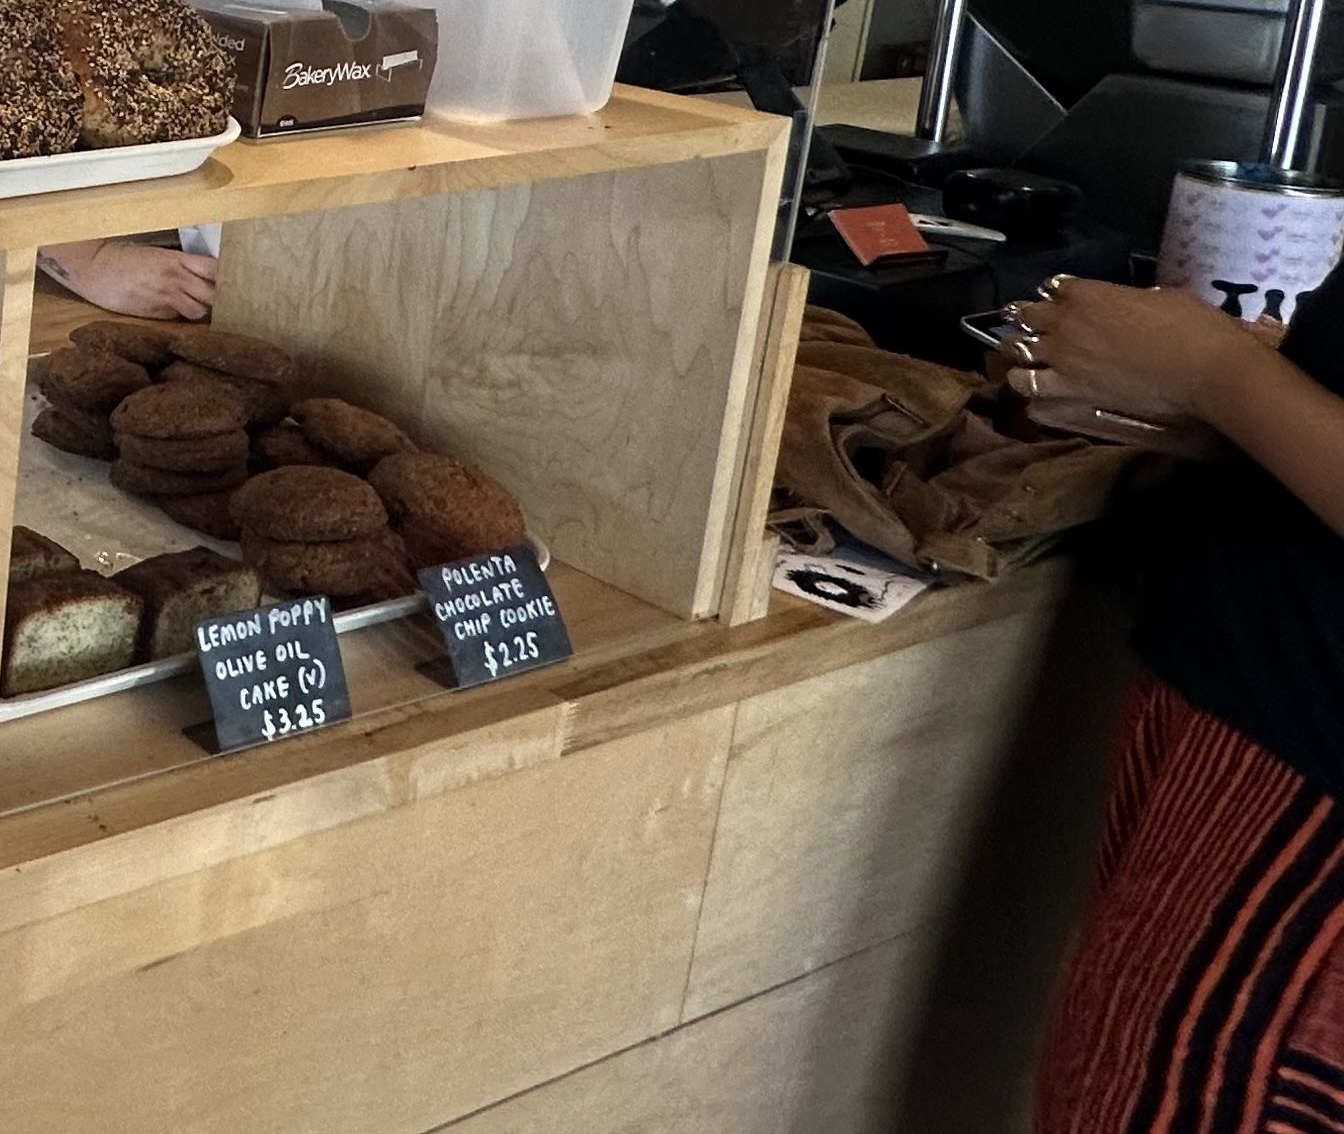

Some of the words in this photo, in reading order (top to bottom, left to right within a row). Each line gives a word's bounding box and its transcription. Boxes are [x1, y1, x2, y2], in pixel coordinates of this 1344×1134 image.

[282, 61, 371, 91] BakeryWax
[441, 554, 518, 592] POLENTA
[435, 578, 525, 622] CHOCOLATE
[454, 614, 492, 641] CHIP
[499, 595, 556, 629] COOKIE
[196, 613, 263, 653] LEMON
[268, 597, 328, 636] POPPY
[215, 649, 268, 681] OLIVE
[274, 640, 310, 663] OIL
[483, 631, 539, 681] $2.25
[239, 675, 291, 710] CAKE
[261, 698, 327, 742] $3.25
